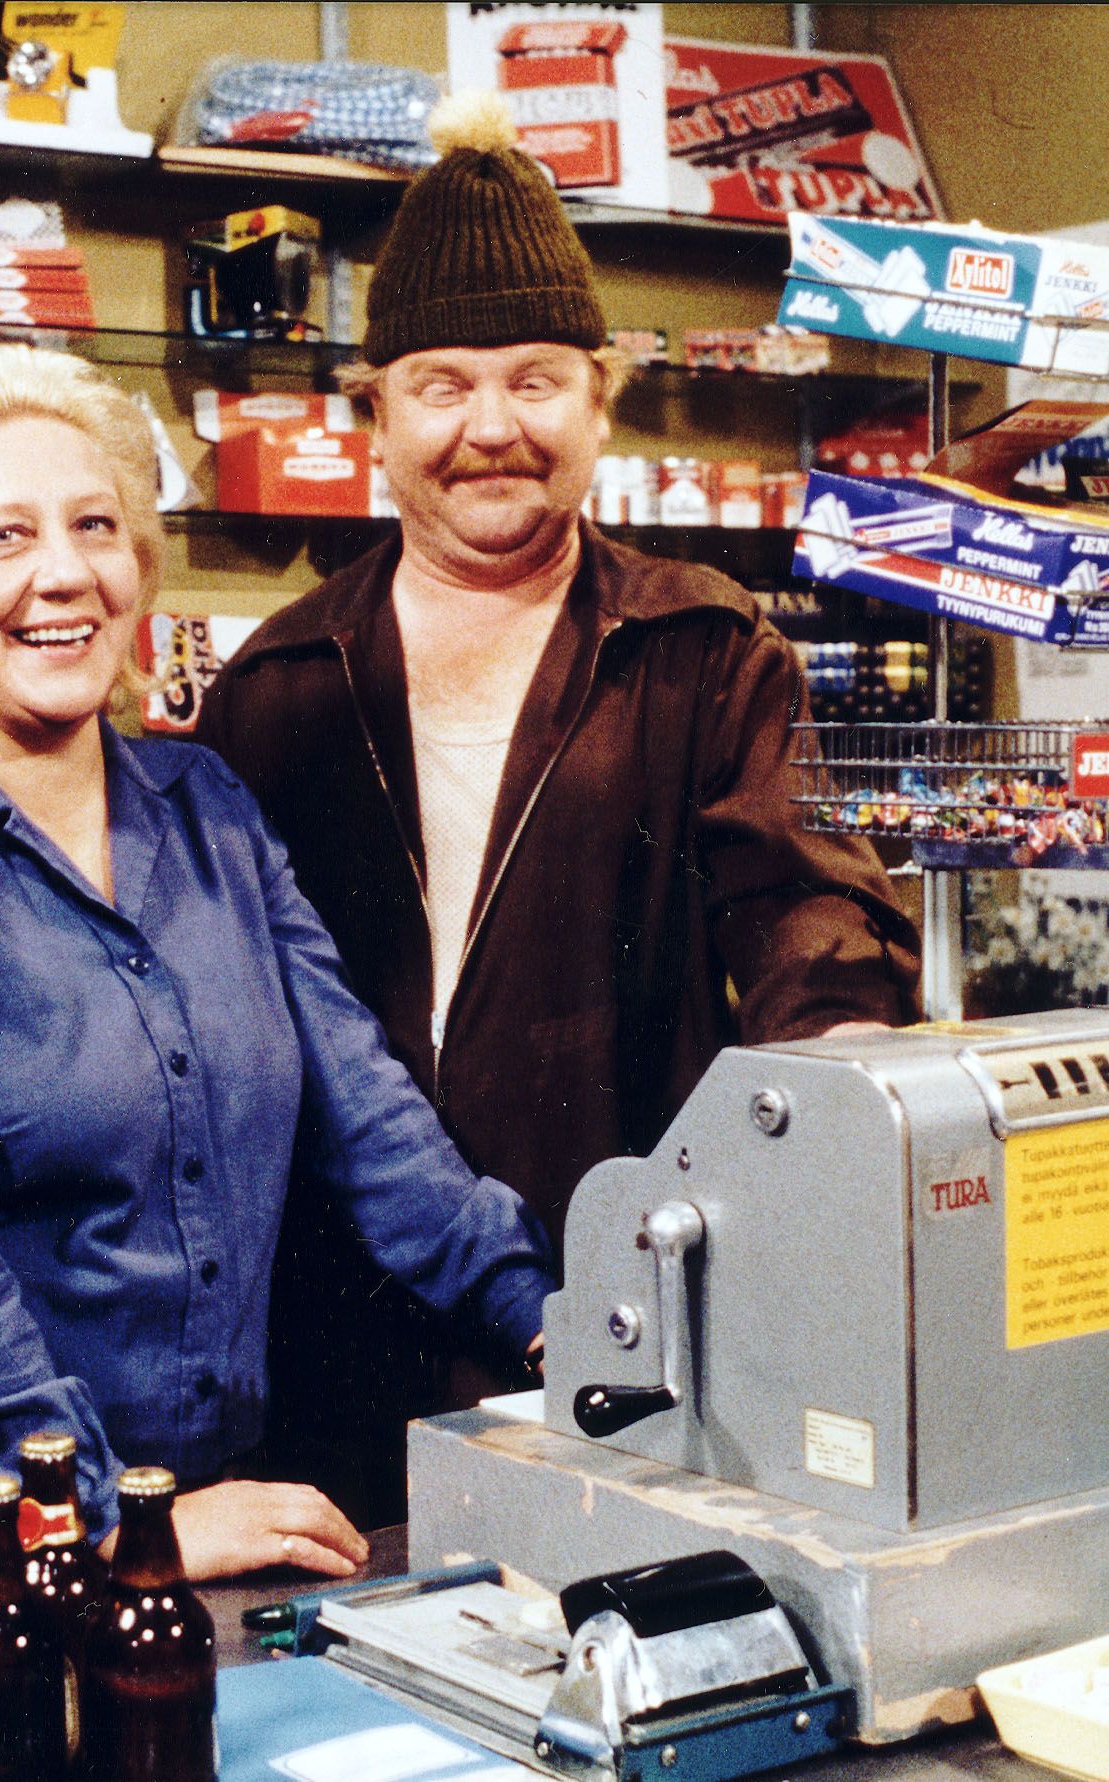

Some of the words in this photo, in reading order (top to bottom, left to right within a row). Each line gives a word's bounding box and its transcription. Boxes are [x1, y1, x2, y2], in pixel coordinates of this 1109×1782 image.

[952, 253, 1009, 291] Xylitol
[923, 313, 1020, 343] PEPPERMINT
[956, 545, 1044, 580] PEPPERMINT
[944, 568, 1048, 612] JENKKI
[936, 593, 1046, 637] TYYNYPURUKUMI
[930, 1175, 991, 1212] TURA
